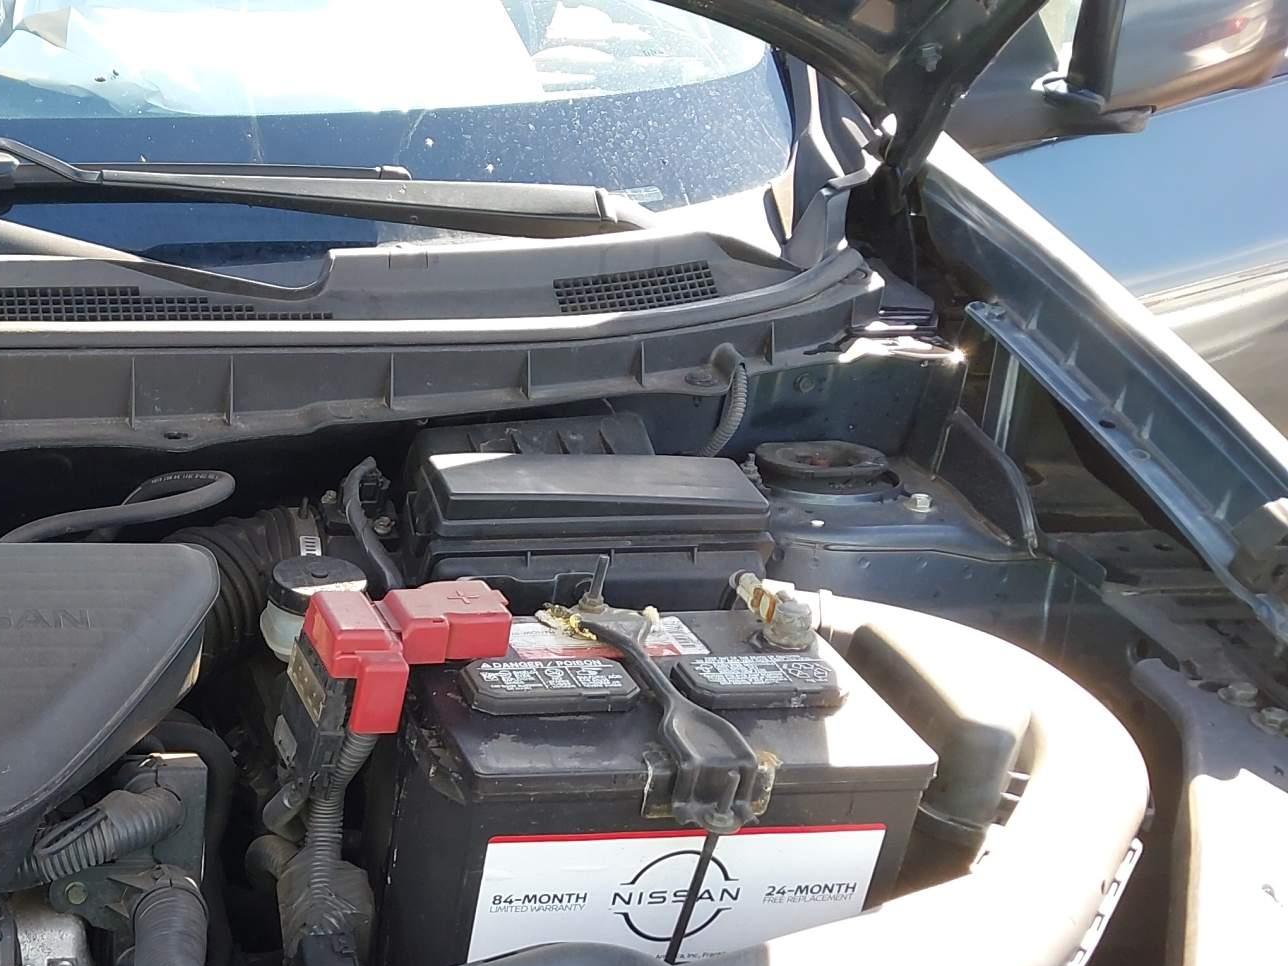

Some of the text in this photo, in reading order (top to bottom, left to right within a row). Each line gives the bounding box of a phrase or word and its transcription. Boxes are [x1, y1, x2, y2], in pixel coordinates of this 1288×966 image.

[493, 659, 543, 669] DANGER
[556, 659, 603, 667] POISON
[765, 882, 857, 897] 24-MONTH
[492, 892, 587, 906] 84-MONTH
[610, 887, 741, 906] NISSAN
[762, 893, 854, 904] FREE REPLACEMENT
[490, 903, 586, 913] LIMITED WARRANTY
